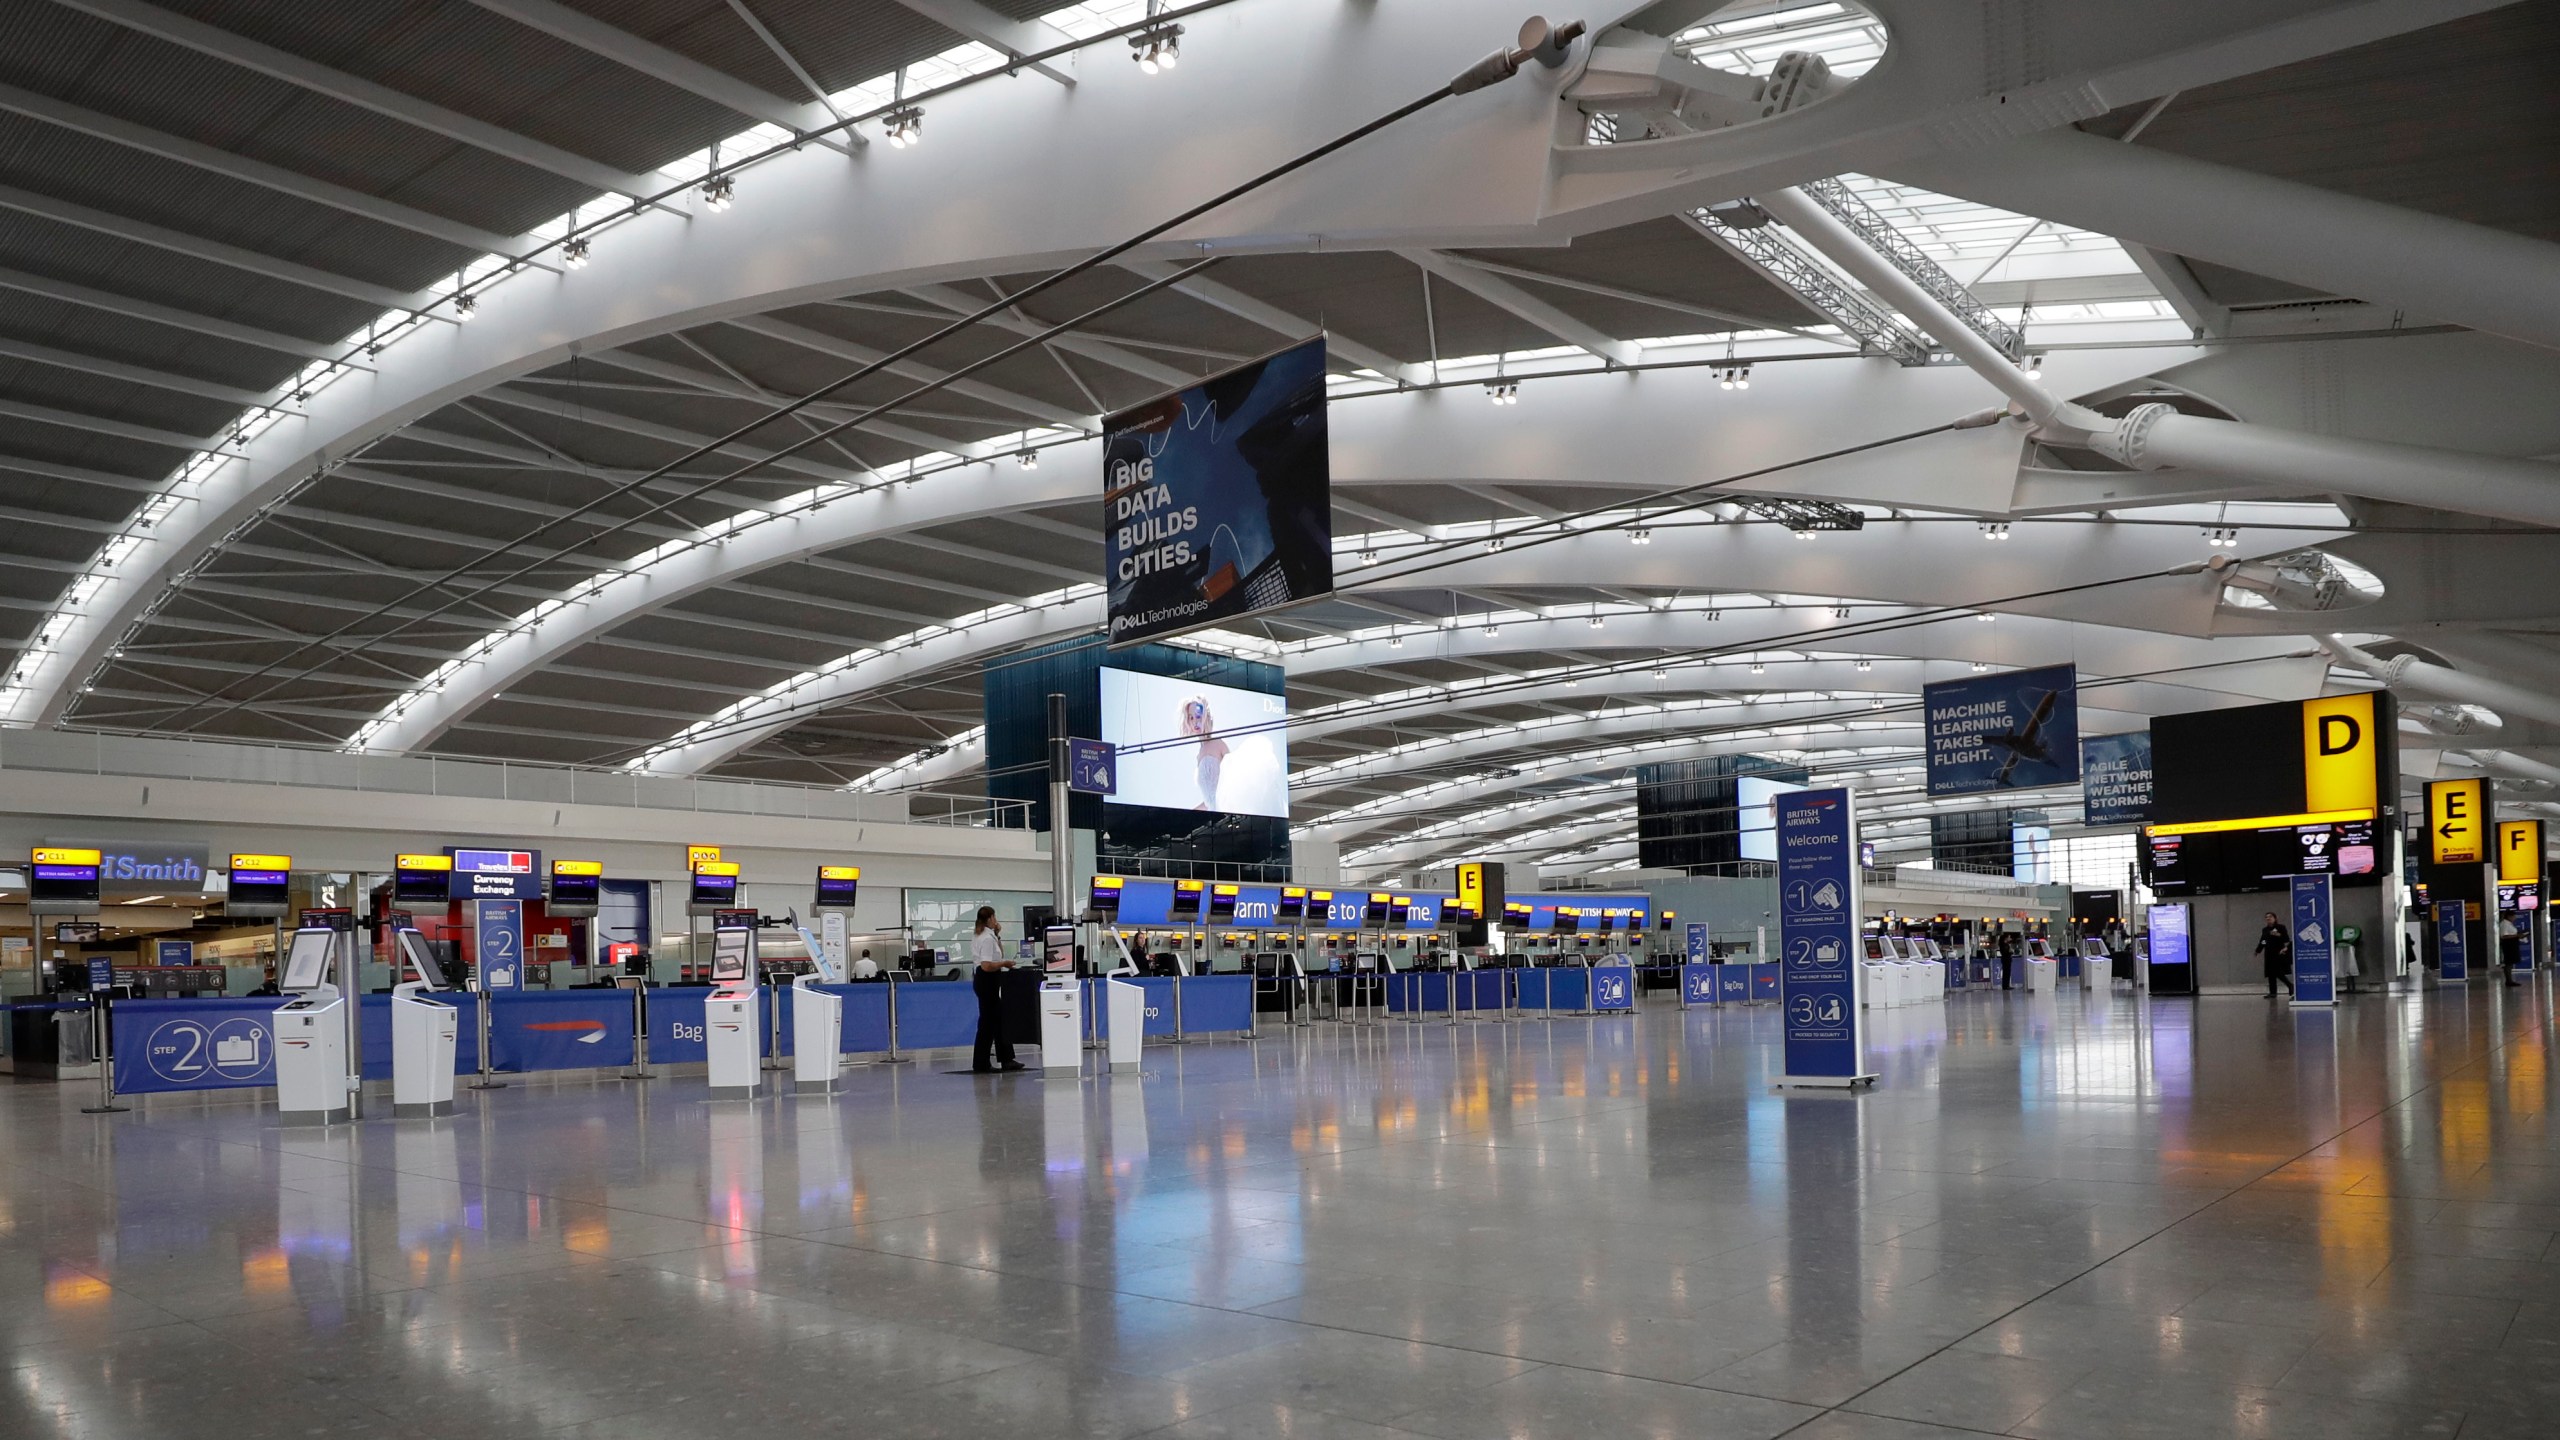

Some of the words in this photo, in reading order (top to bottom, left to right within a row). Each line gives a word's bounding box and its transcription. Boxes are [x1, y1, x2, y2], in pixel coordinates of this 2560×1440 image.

[1116, 458, 1153, 490] BIG
[1117, 483, 1171, 520] DATA
[1118, 506, 1198, 551] BUILDS
[1119, 541, 1197, 580] CITIES.
[1932, 700, 2007, 721] MACHINE
[1933, 715, 2014, 736] LEARNING
[2318, 714, 2361, 756] D
[1933, 734, 1984, 751] TAKES
[1934, 748, 1994, 766] FLIGHT.
[2089, 760, 2128, 773] AGILE
[1084, 765, 1089, 784] 1
[2090, 795, 2152, 809] STORMS.
[2446, 791, 2467, 819] E
[1785, 816, 1820, 827] AIRWAYS
[1786, 809, 1819, 819] BRITISH
[1786, 834, 1839, 847] Welcome
[2511, 830, 2526, 850] F
[100, 855, 200, 881] HSmith
[474, 875, 514, 885] Currency
[1465, 872, 1476, 890] E
[322, 892, 336, 908] S
[473, 885, 515, 896] Exchange
[1798, 885, 1805, 908] 1
[1341, 903, 1356, 920] to
[1407, 906, 1433, 921] me.
[2309, 897, 2316, 917] 1
[498, 931, 513, 956] 2
[1696, 937, 1704, 950] 2
[1797, 940, 1811, 964] 2
[1604, 980, 1611, 1000] 2
[1692, 977, 1699, 996] 2
[1724, 981, 1733, 992] Bag
[1733, 980, 1743, 991] Drop
[1799, 998, 1813, 1023] 3
[673, 1022, 703, 1042] Bag
[154, 1046, 177, 1054] STEP
[172, 1026, 203, 1072] 2
